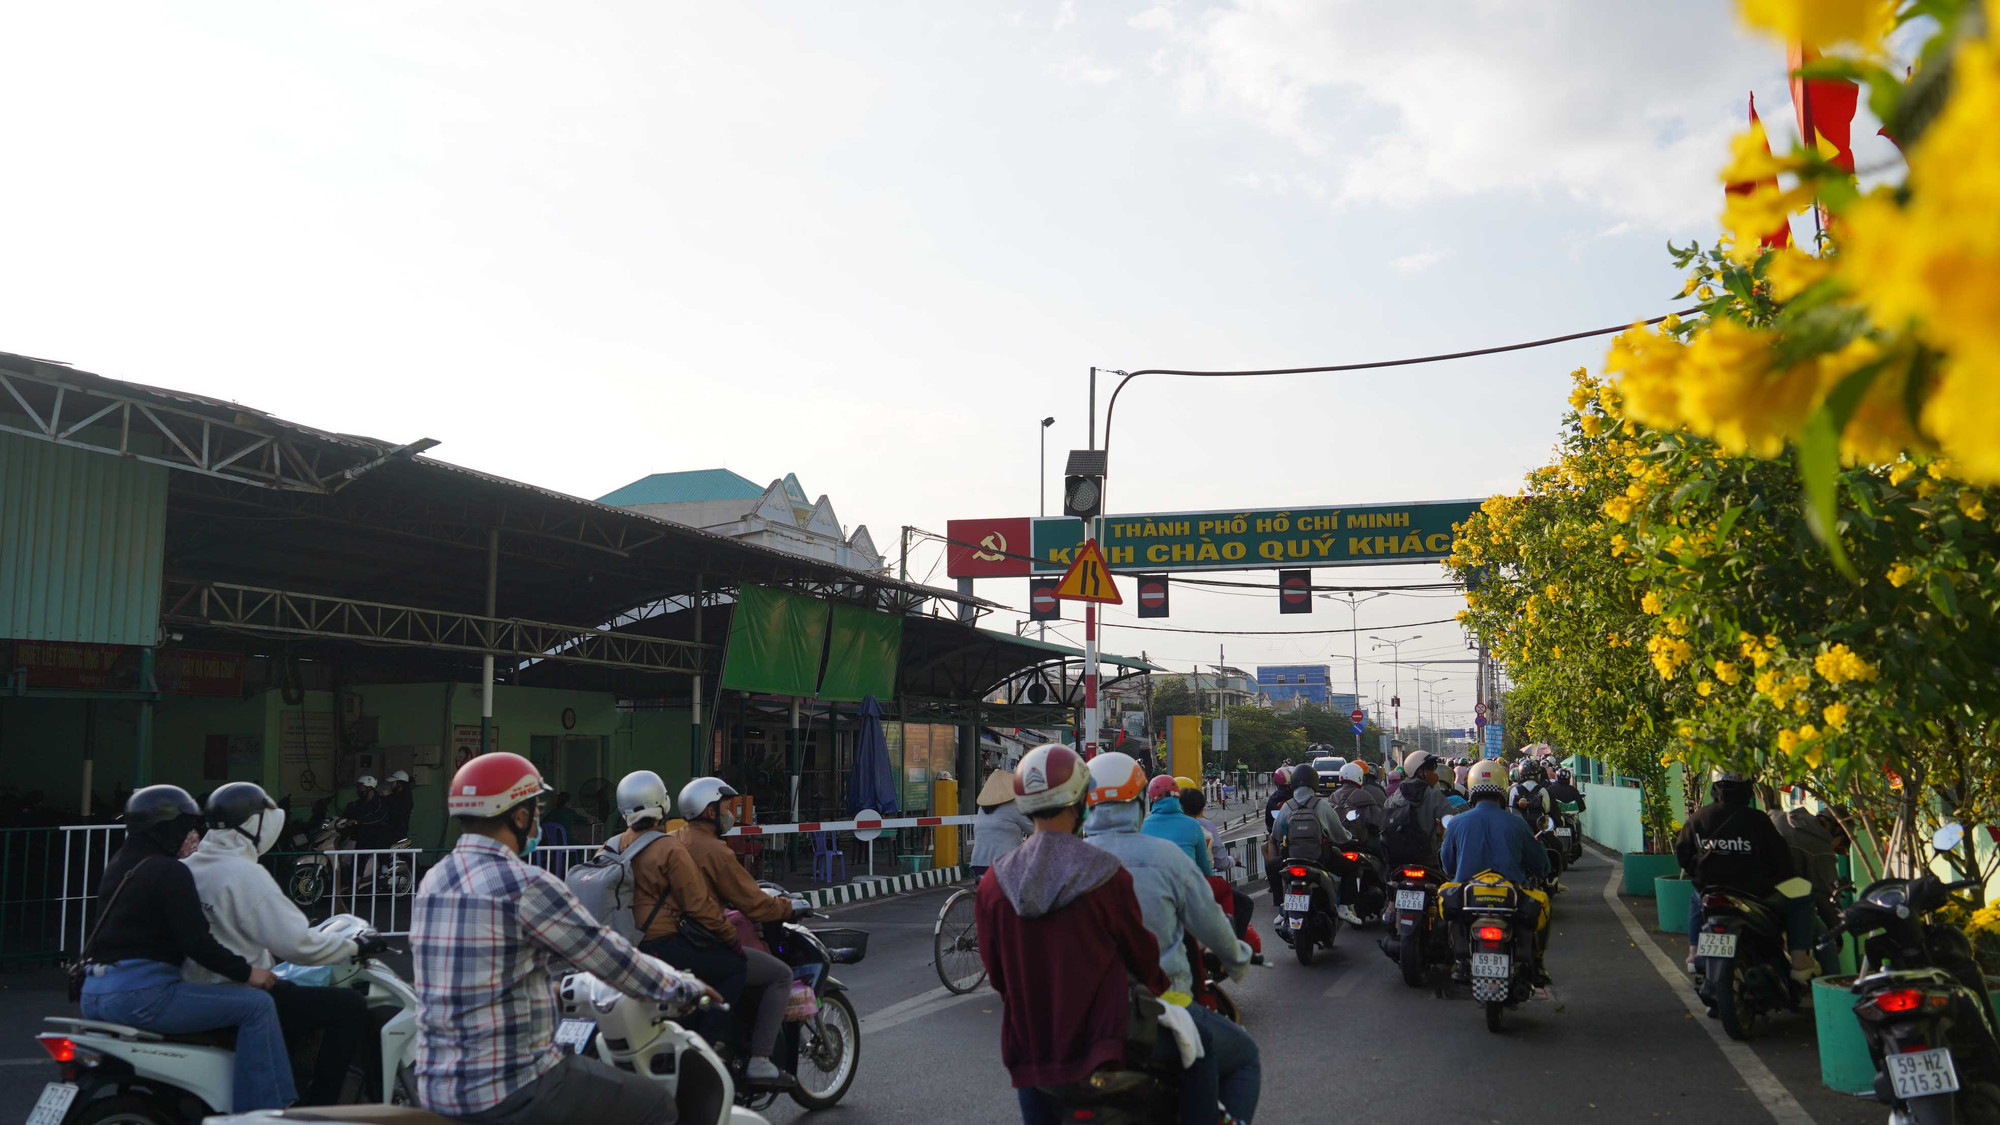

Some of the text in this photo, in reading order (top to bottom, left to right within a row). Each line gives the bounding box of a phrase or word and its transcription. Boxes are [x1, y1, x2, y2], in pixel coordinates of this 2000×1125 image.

[1111, 510, 1410, 538] THÀNH PHỐ HỒ CHÍ MINH
[1049, 529, 1462, 565] KÍH CHÀO QUÝ KHÁC
[1288, 894, 1306, 903] 72-E1
[1397, 899, 1422, 908] 402.66
[1705, 934, 1730, 944] 72-E1
[1700, 944, 1734, 955] 577.60
[1478, 954, 1503, 965] 59-B1
[1475, 965, 1506, 976] 685.27
[1897, 1053, 1944, 1075] 59-H2
[1898, 1070, 1952, 1095] 215.31
